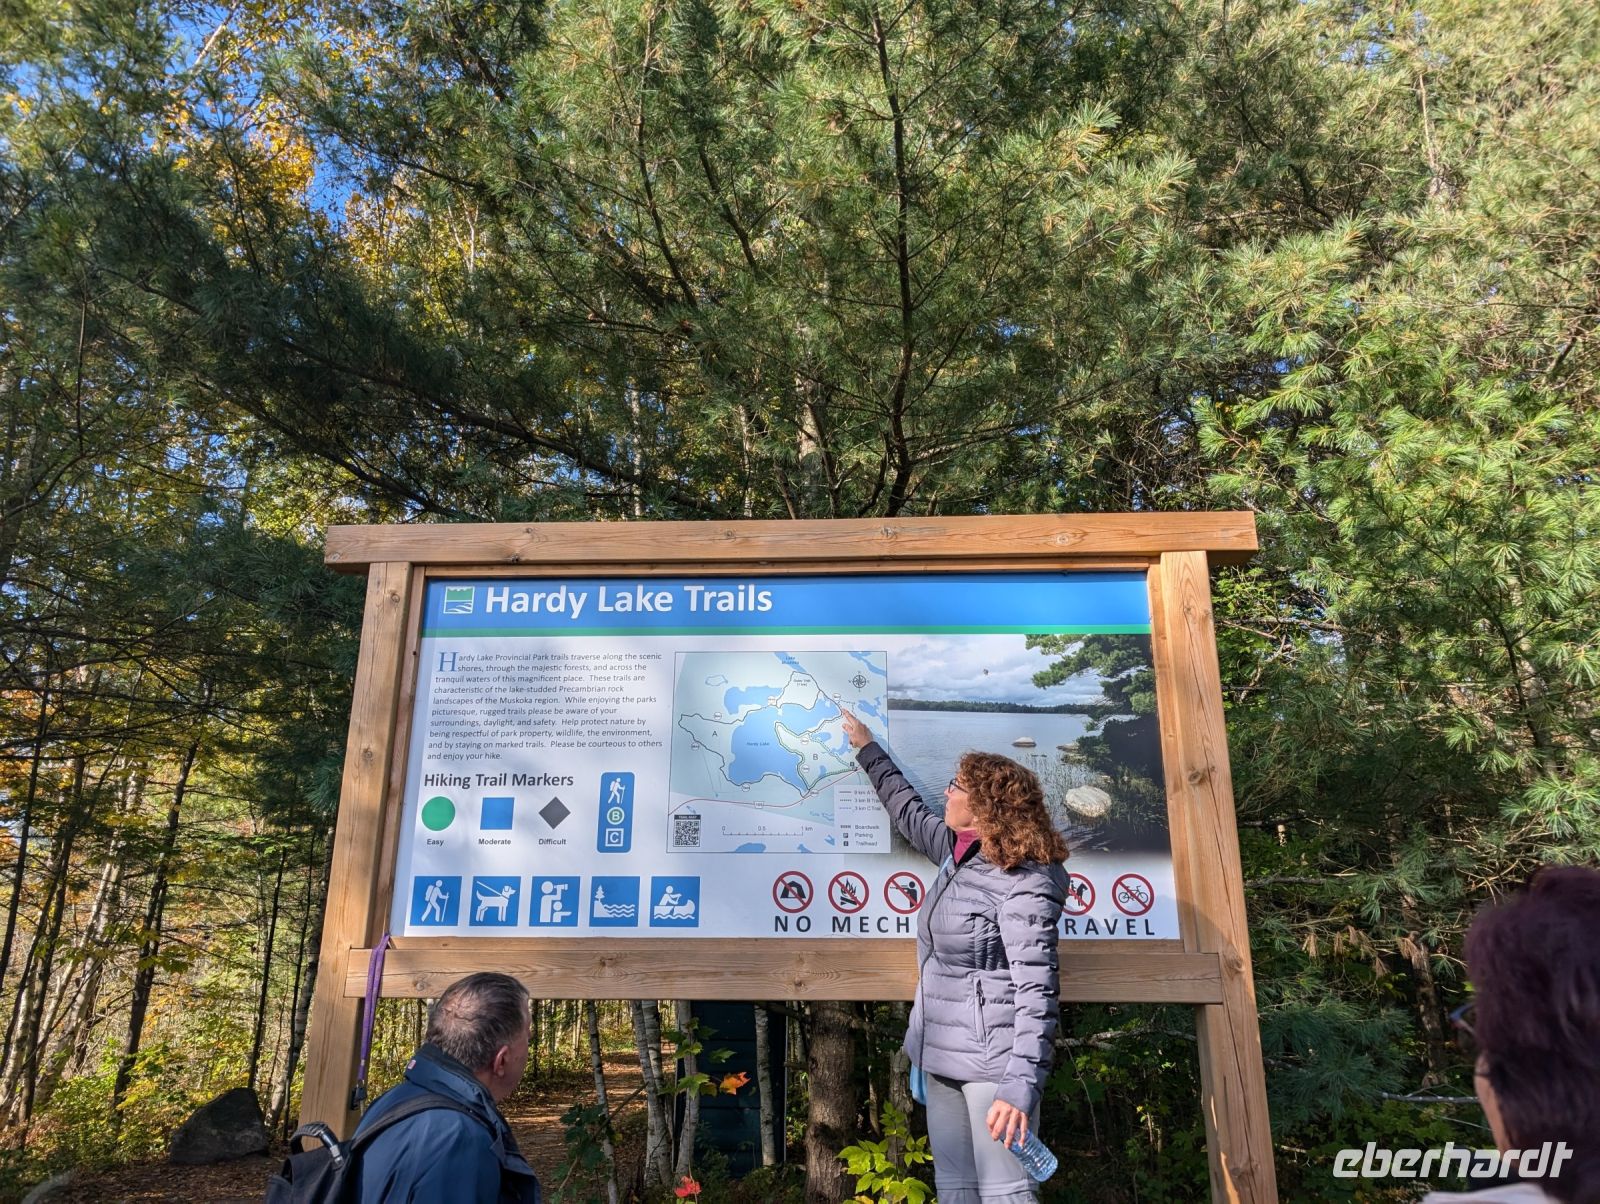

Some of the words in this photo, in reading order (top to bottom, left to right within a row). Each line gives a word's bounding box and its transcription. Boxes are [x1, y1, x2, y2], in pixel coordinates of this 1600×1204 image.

[485, 585, 587, 619] Hardy
[598, 585, 674, 612] Lake
[684, 584, 772, 612] Trails
[602, 653, 622, 662] along
[534, 697, 560, 705] region.
[483, 719, 515, 727] daylight,
[424, 774, 471, 789] Hiking
[476, 774, 507, 786] Trail
[512, 774, 574, 786] Markers
[612, 811, 620, 820] B
[610, 832, 619, 843] C
[774, 915, 812, 933] NO
[832, 916, 910, 933] MECH
[1064, 918, 1155, 935] RAVEL
